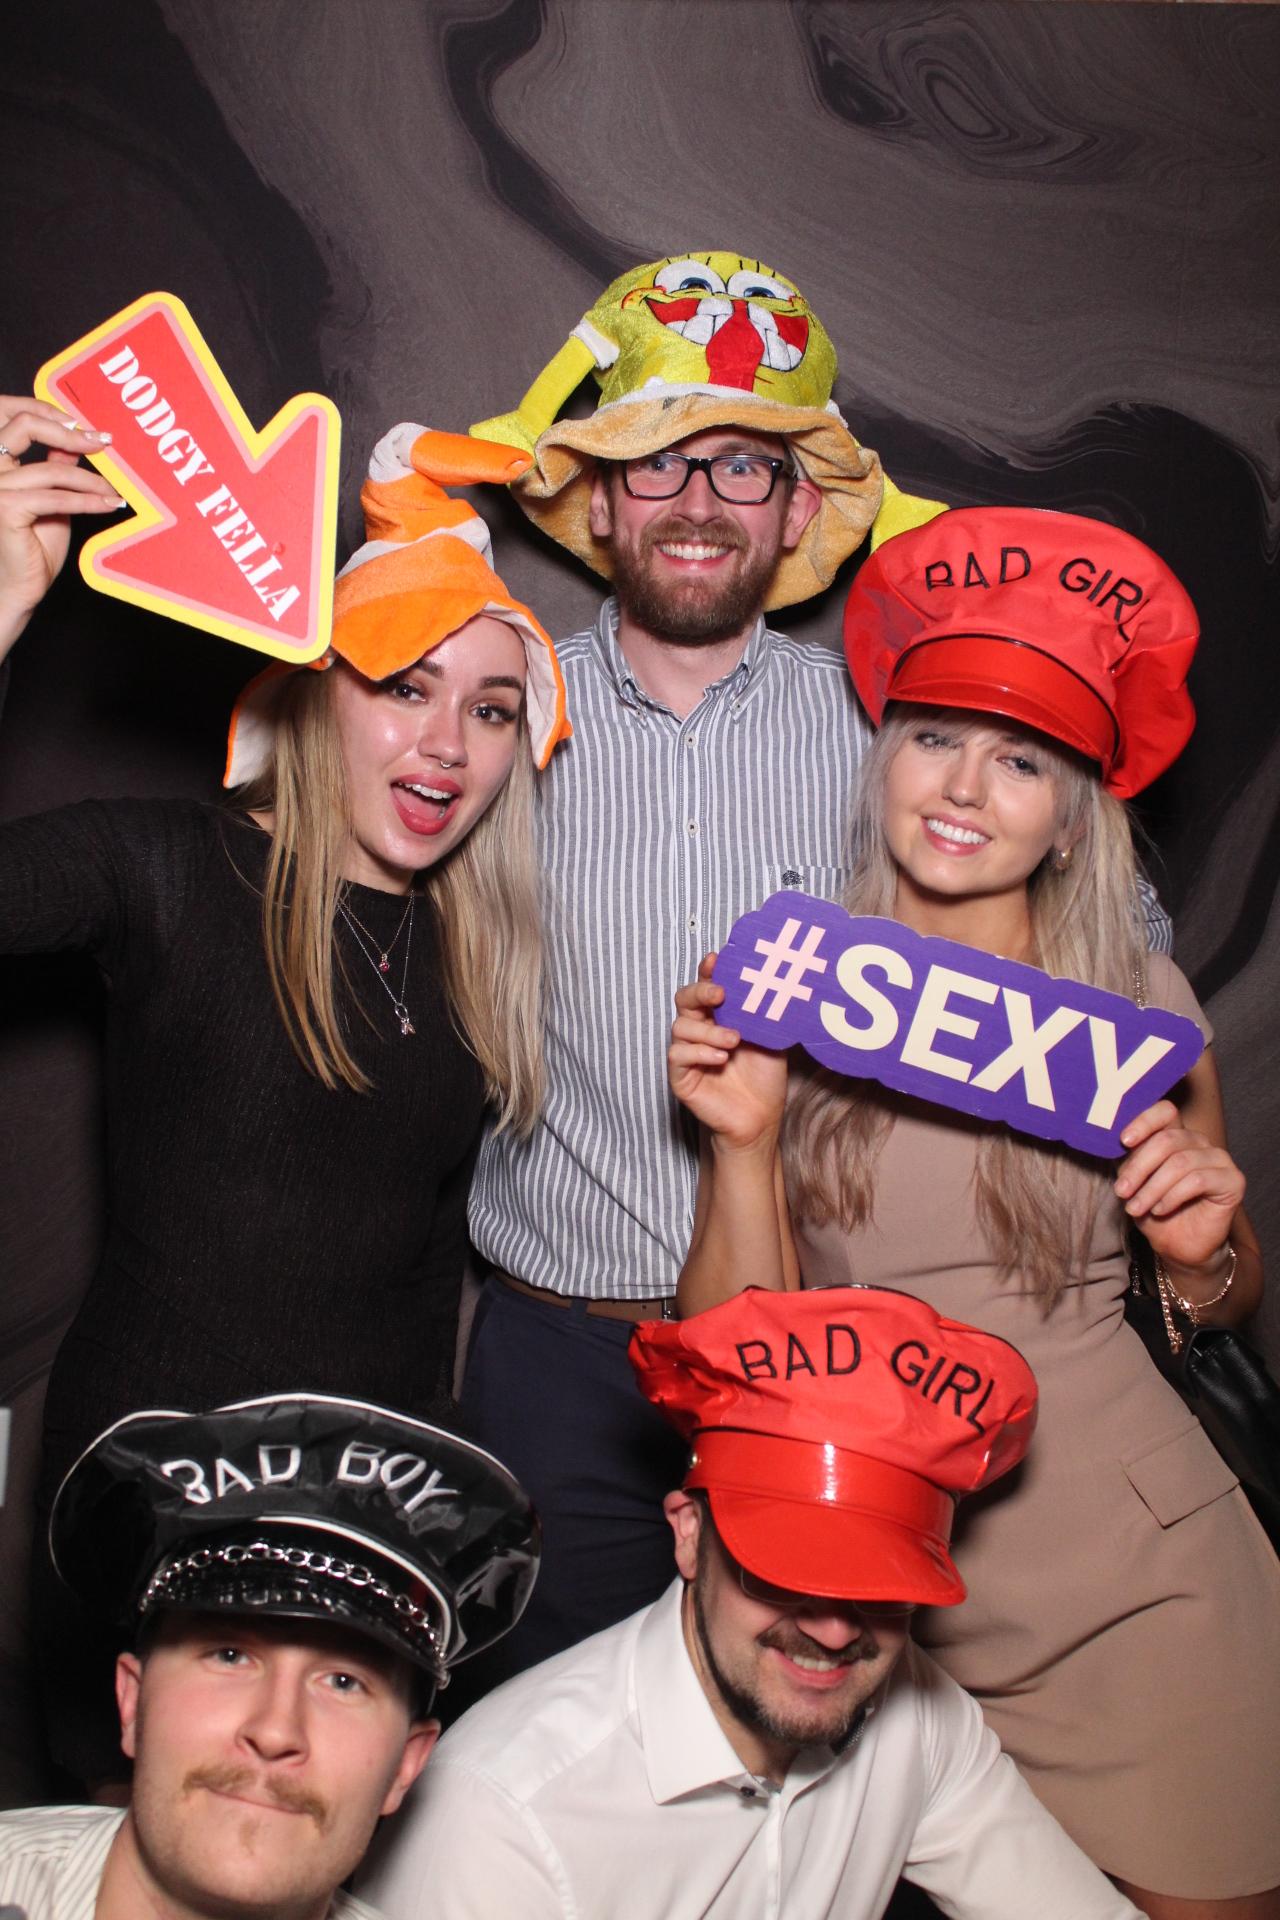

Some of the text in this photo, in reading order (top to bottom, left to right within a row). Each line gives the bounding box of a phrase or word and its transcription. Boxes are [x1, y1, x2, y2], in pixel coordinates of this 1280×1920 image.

[99, 345, 301, 622] DODGY FELLA
[739, 917, 1177, 1131] #SEXY
[735, 1323, 997, 1436] BAD GIRL
[336, 1440, 461, 1514] BOY
